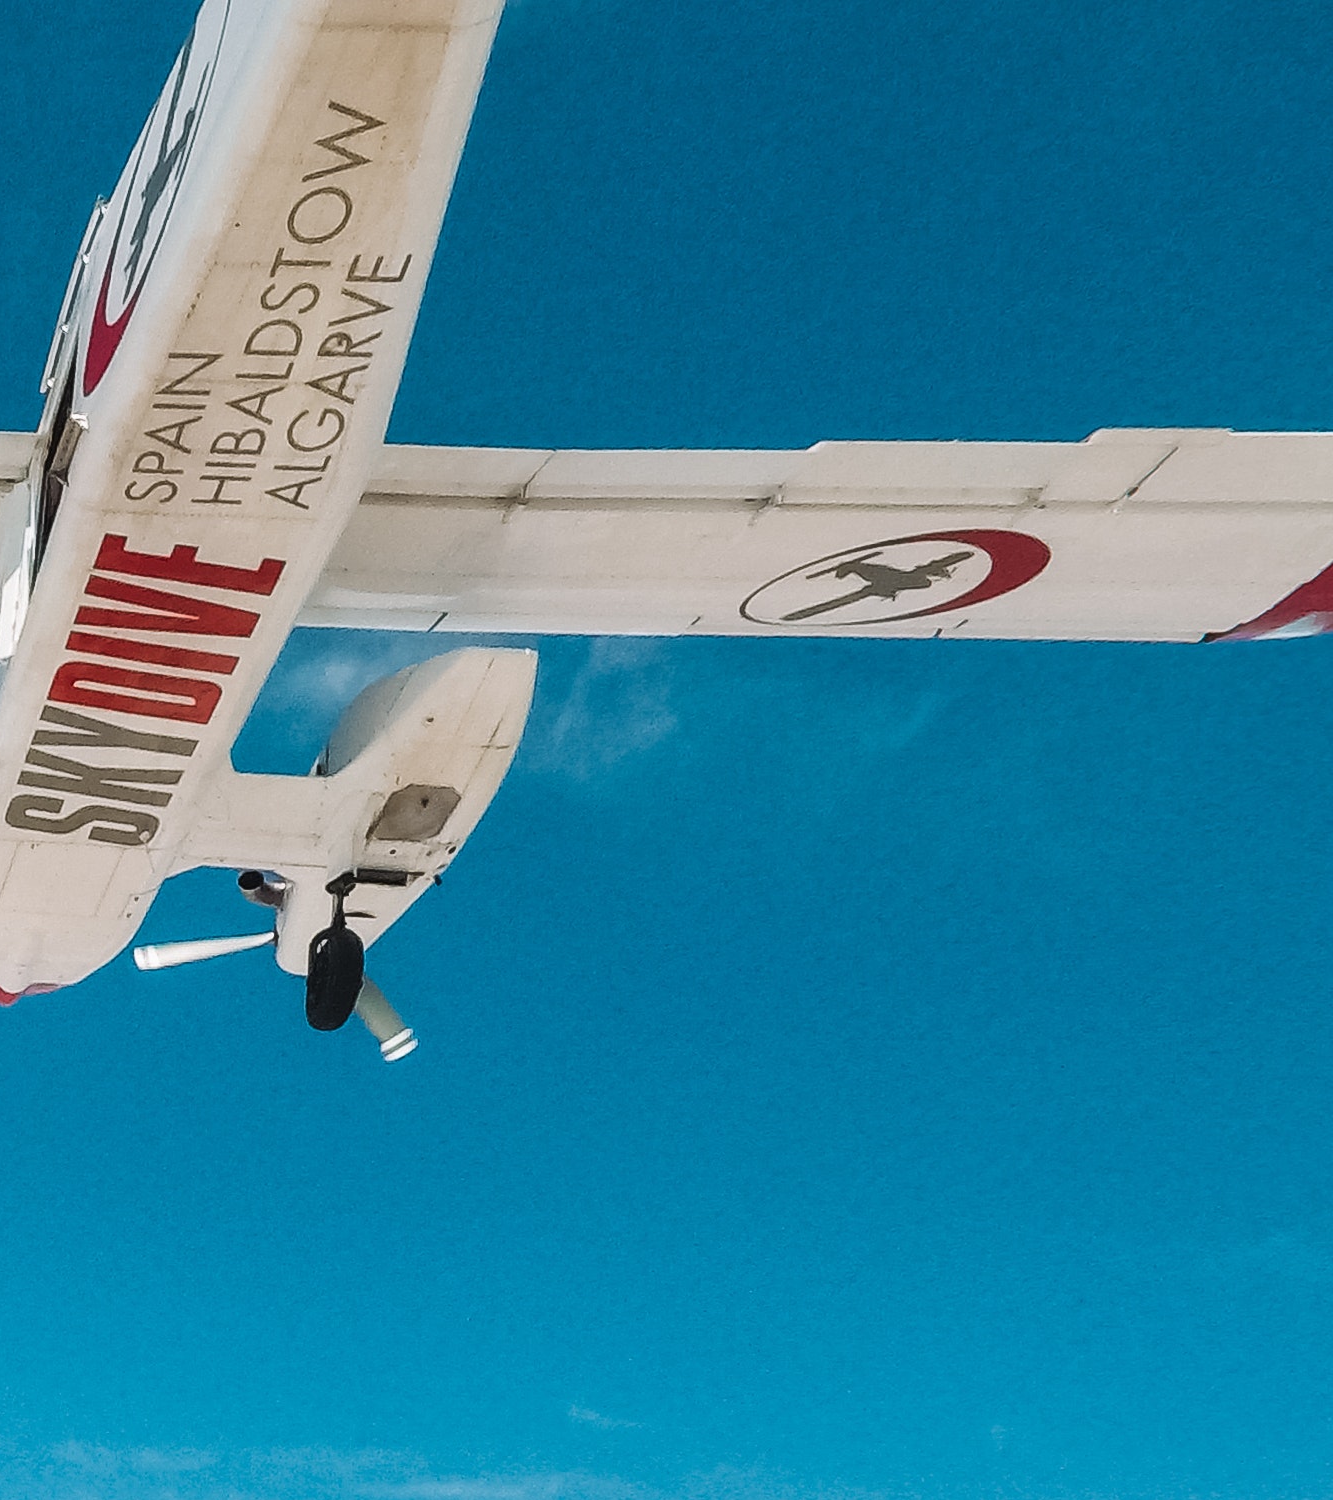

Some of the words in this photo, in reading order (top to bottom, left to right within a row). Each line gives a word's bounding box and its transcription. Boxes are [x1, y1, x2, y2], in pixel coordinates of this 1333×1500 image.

[125, 352, 224, 503] SPAIN
[190, 100, 387, 506] HIBALDSTOW
[264, 253, 412, 510] ALGARVE
[4, 533, 287, 846] SKYDIVE
